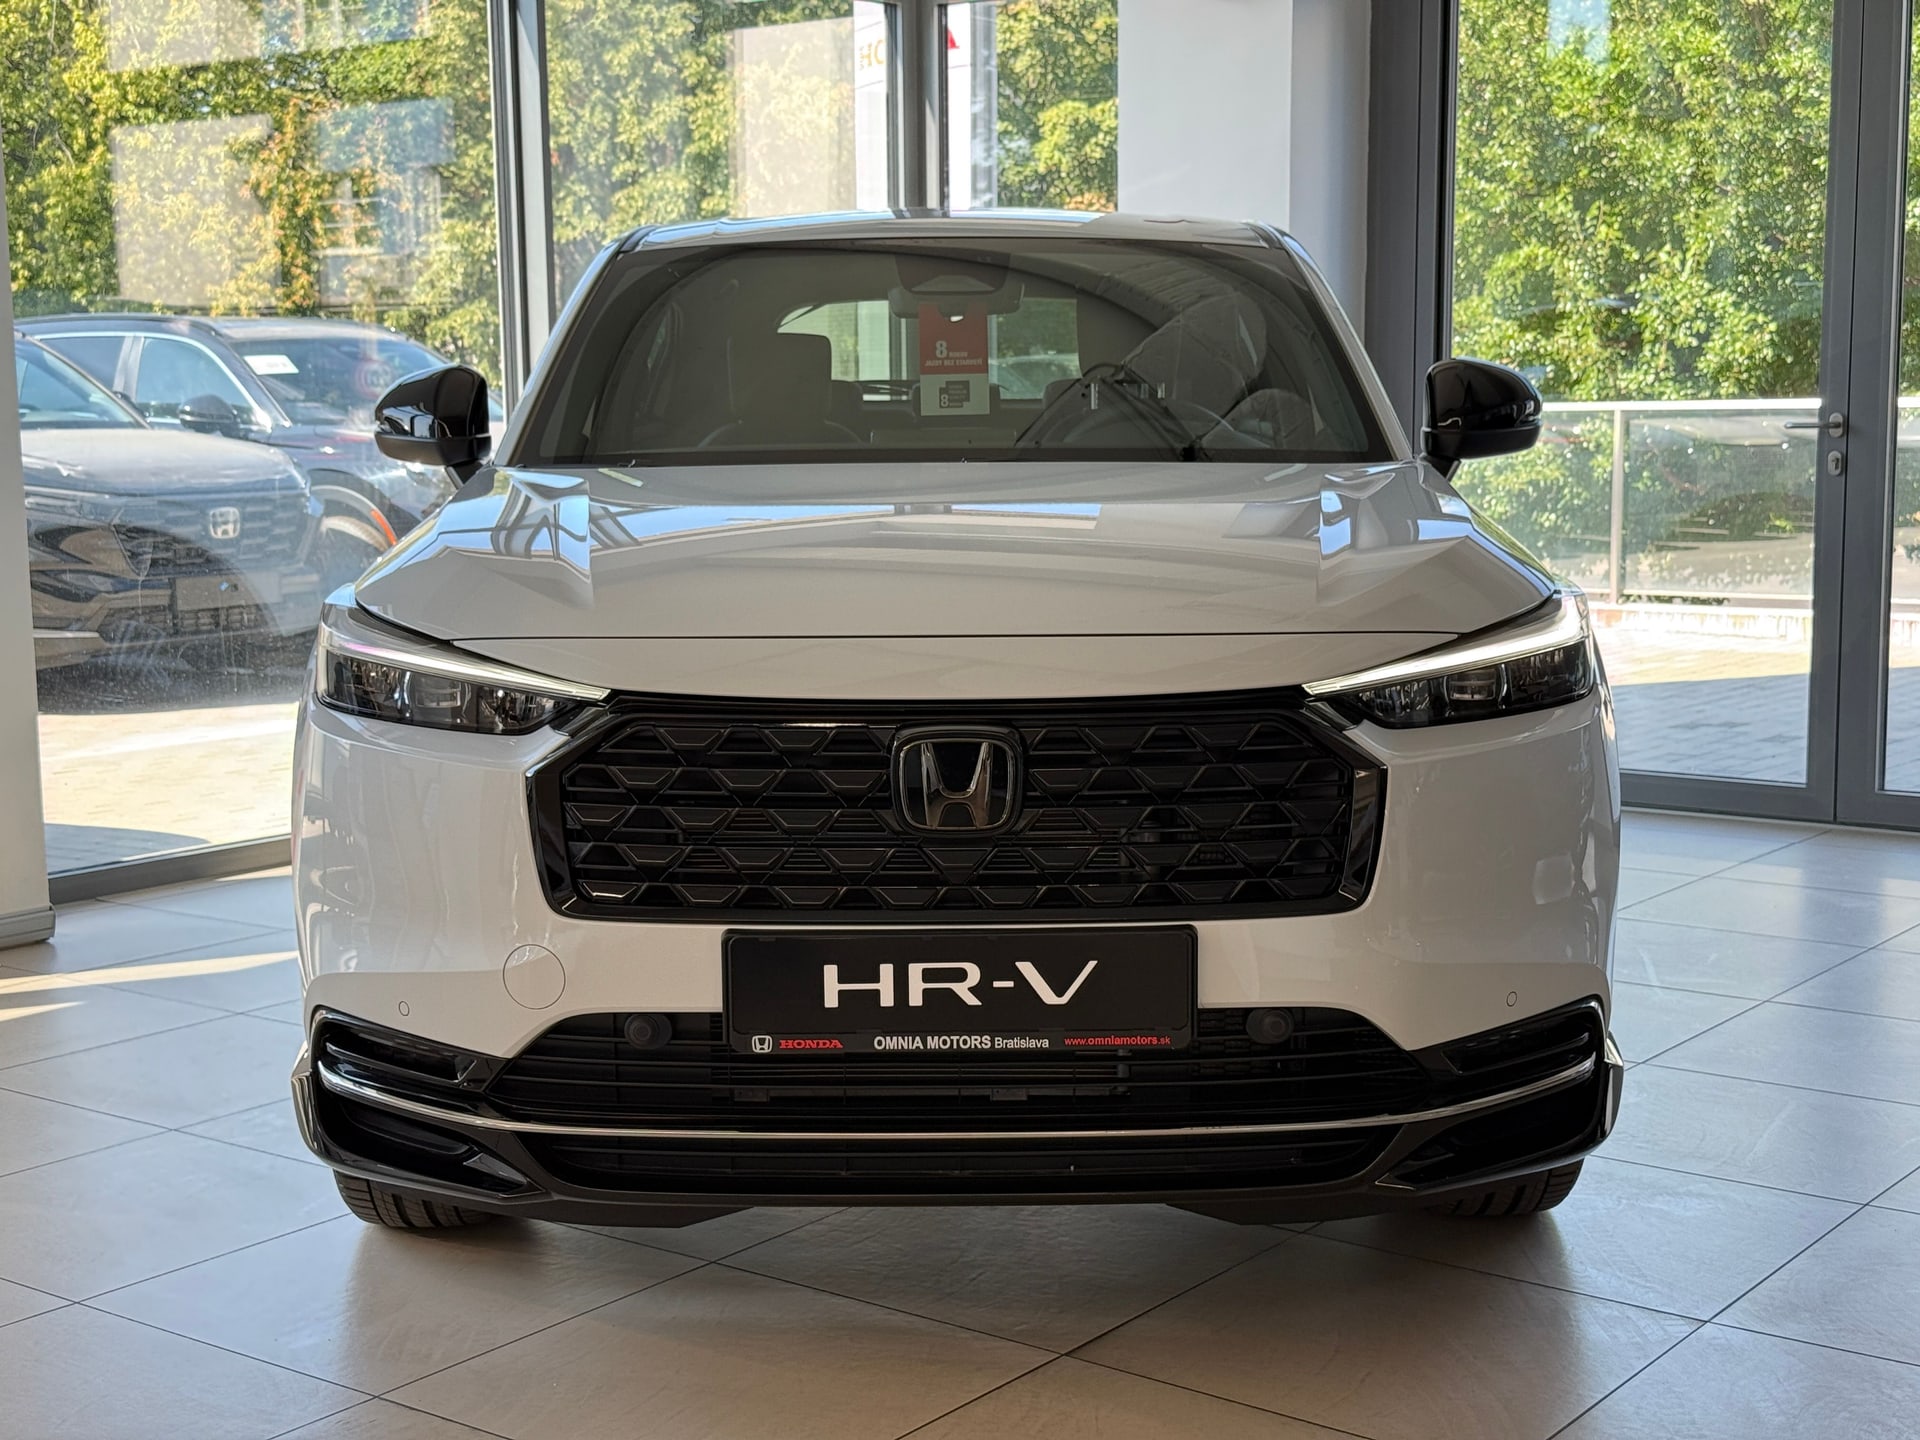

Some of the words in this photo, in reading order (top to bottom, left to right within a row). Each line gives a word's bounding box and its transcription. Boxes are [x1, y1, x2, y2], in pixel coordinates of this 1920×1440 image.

[936, 340, 948, 358] 8
[940, 394, 949, 407] 8
[823, 960, 1098, 1008] HR-V
[779, 1039, 844, 1049] HONDA
[873, 1036, 924, 1050] OMNIA
[926, 1035, 992, 1049] MOTORS
[994, 1036, 1050, 1049] Bratislava
[1064, 1035, 1171, 1046] www.omniamotors.sk
